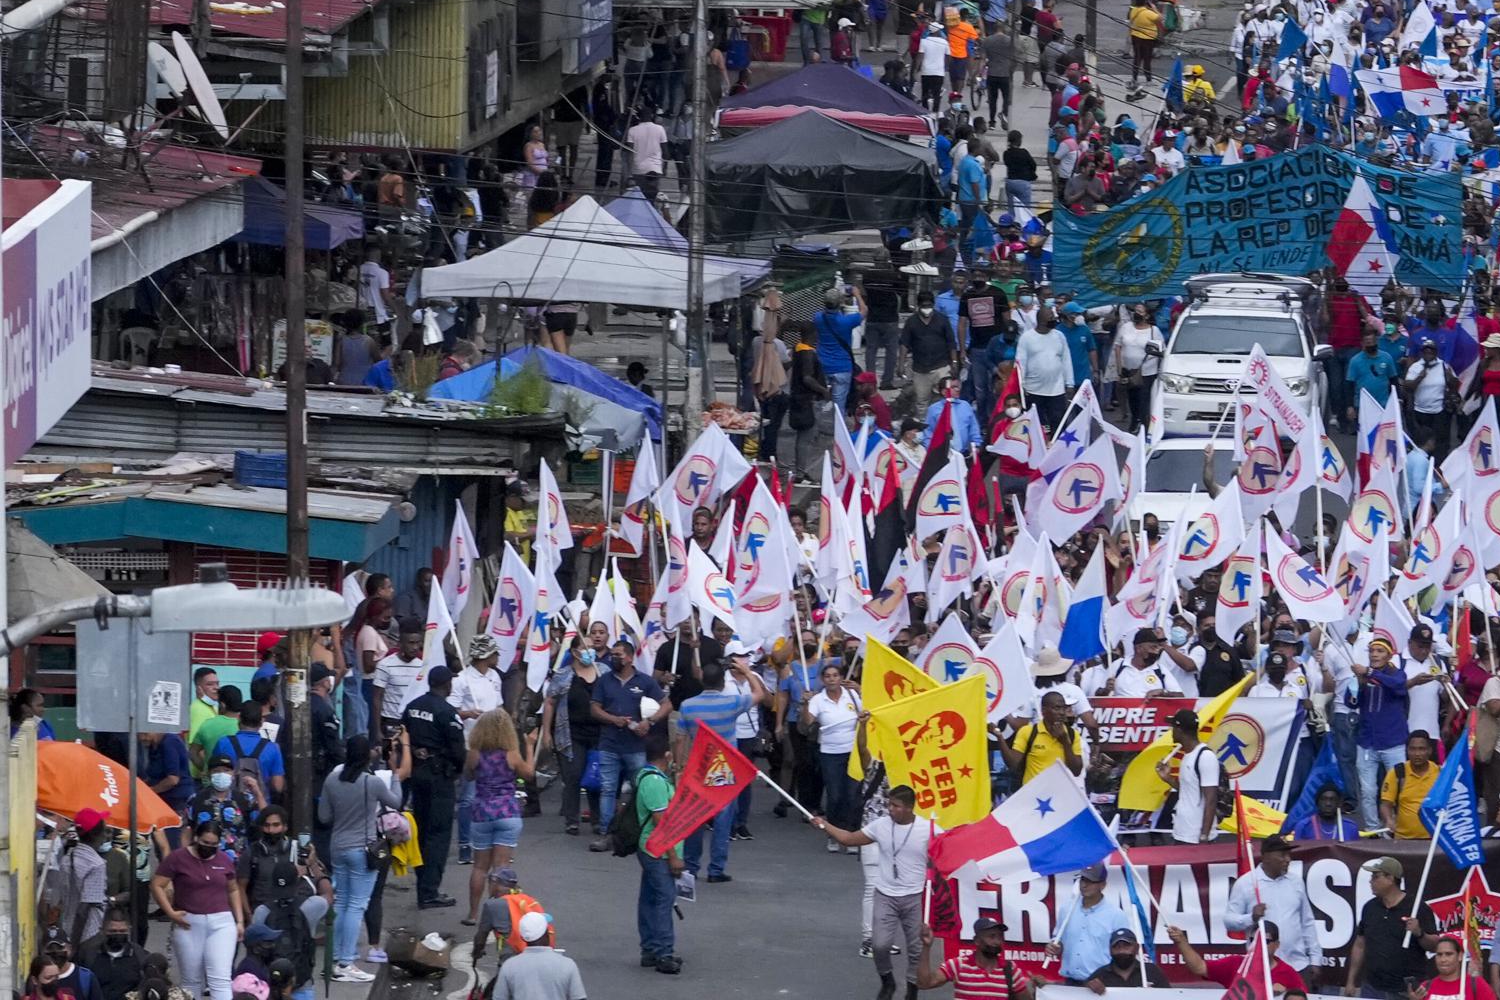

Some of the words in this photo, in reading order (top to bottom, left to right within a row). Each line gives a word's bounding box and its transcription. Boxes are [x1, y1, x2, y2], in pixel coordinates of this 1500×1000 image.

[1375, 174, 1418, 200] DE
[1385, 204, 1425, 230] DE
[1187, 230, 1228, 260] LA
[1239, 220, 1291, 252] REP
[1232, 255, 1255, 273] SE
[1261, 244, 1311, 270] VENDE
[909, 768, 936, 810] 29
[930, 757, 958, 809] FER
[1461, 841, 1481, 862] FB
[1160, 953, 1176, 964] DE
[1338, 957, 1346, 968] Y
